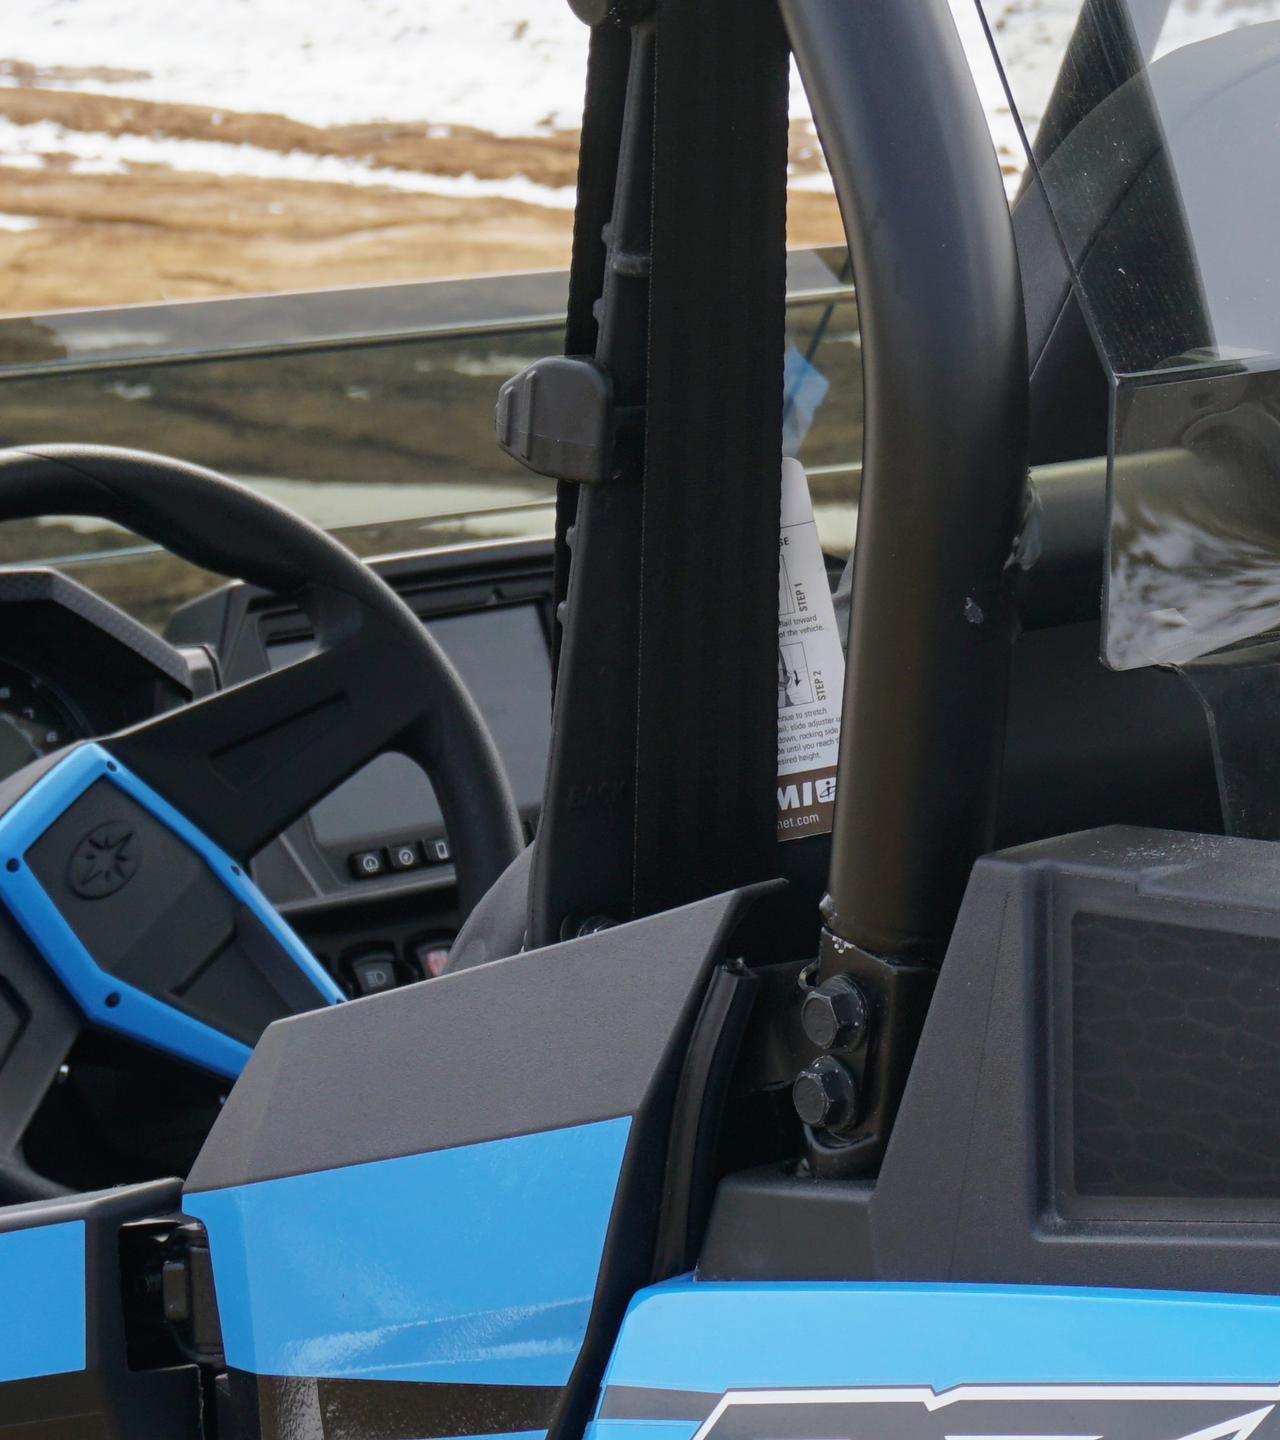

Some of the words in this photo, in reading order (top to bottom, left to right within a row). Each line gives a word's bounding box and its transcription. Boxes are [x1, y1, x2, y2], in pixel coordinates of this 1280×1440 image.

[795, 590, 808, 612] STEP
[793, 614, 817, 626] toward
[787, 627, 798, 636] the
[799, 624, 824, 634] vehicle.
[813, 678, 826, 701] STEP
[804, 707, 827, 718] stretch
[790, 722, 806, 731] slide
[807, 717, 834, 728] adjuster
[799, 731, 823, 740] rocking
[825, 727, 839, 735] side
[787, 744, 801, 753] until
[803, 743, 815, 752] you
[816, 738, 834, 748] reach
[798, 752, 821, 762] height.
